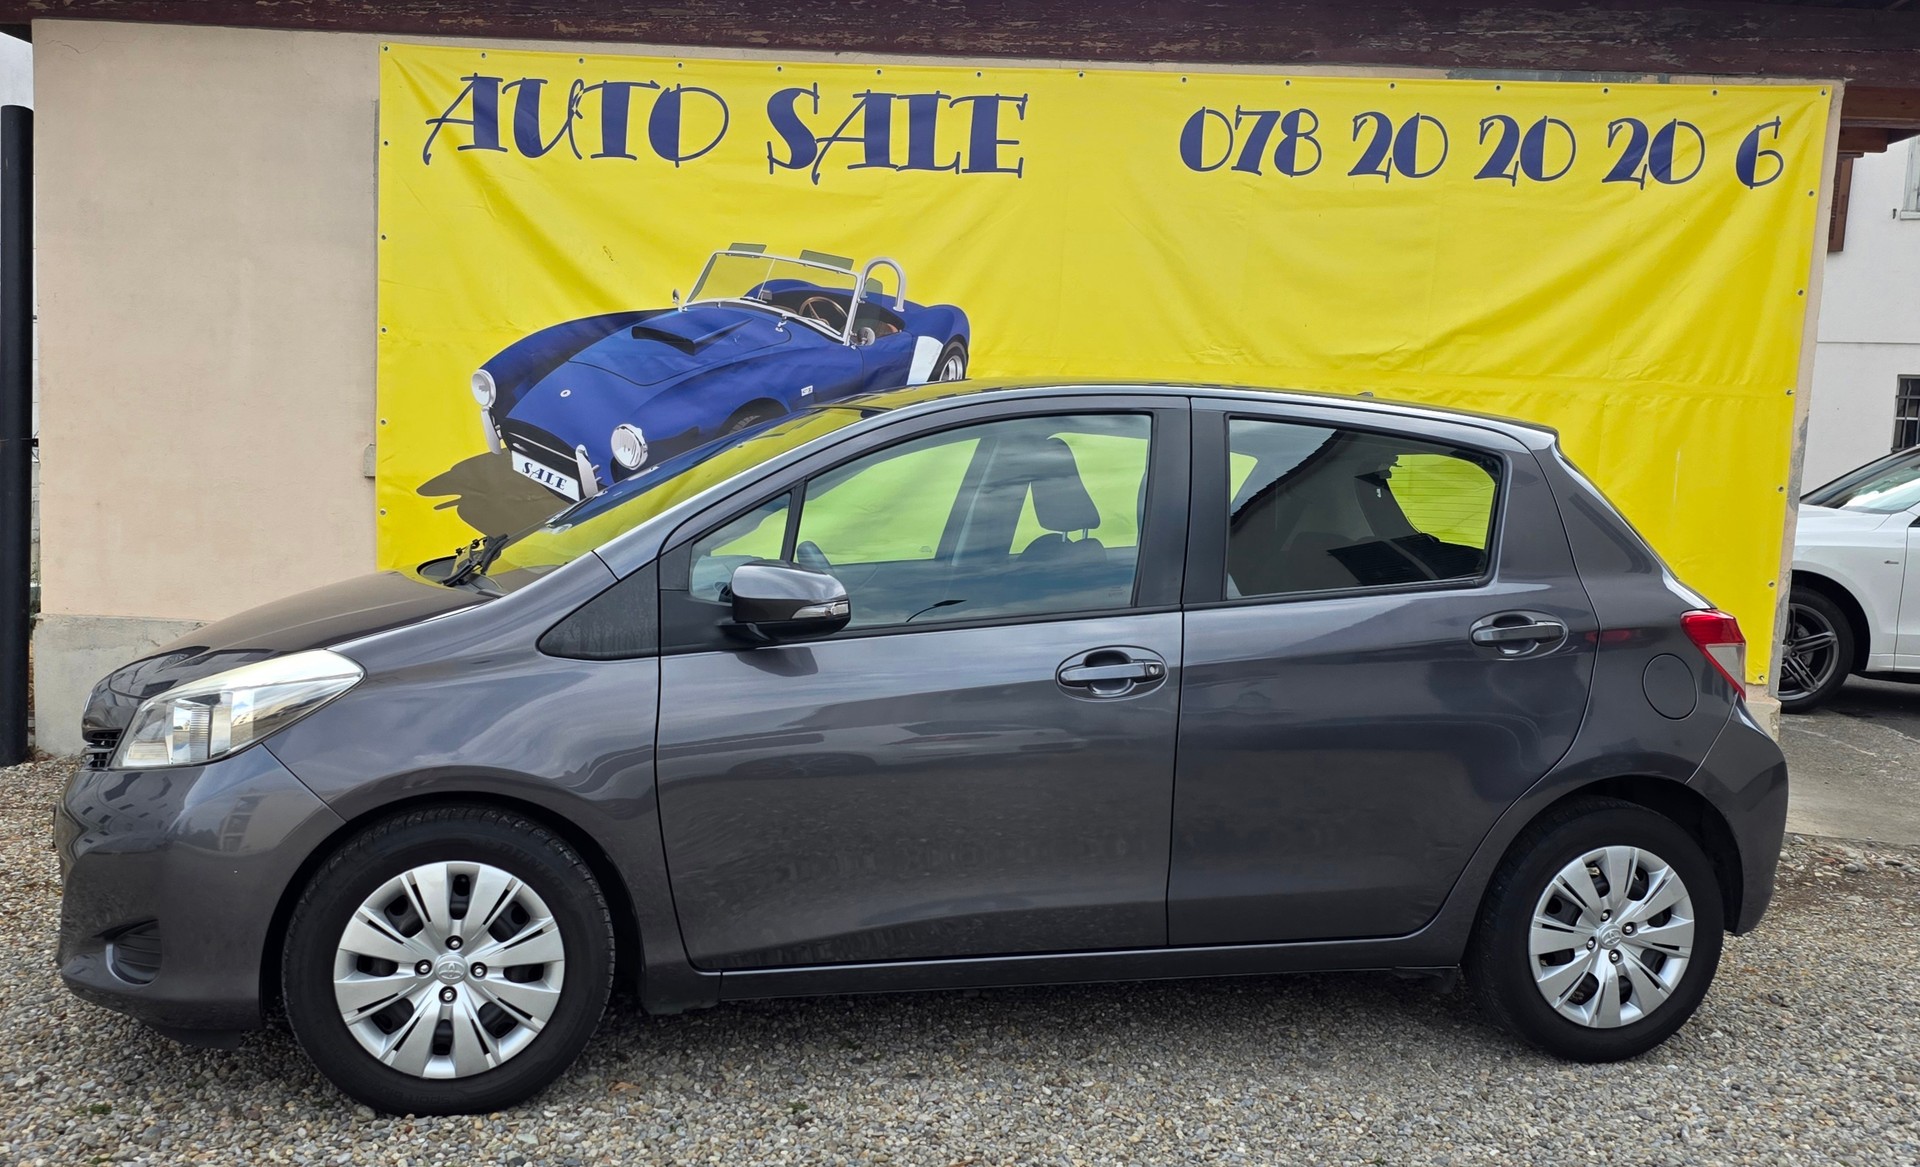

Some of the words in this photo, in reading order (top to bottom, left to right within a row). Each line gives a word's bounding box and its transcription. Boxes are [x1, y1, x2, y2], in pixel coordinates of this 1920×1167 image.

[423, 73, 729, 167] AUTO
[766, 82, 1028, 185] SALE
[1179, 105, 1322, 177] 078
[1347, 111, 1448, 183] 20
[1474, 115, 1576, 187] 20
[1602, 118, 1705, 190] 20
[1735, 115, 1784, 190] 6
[522, 461, 568, 491] SALE
